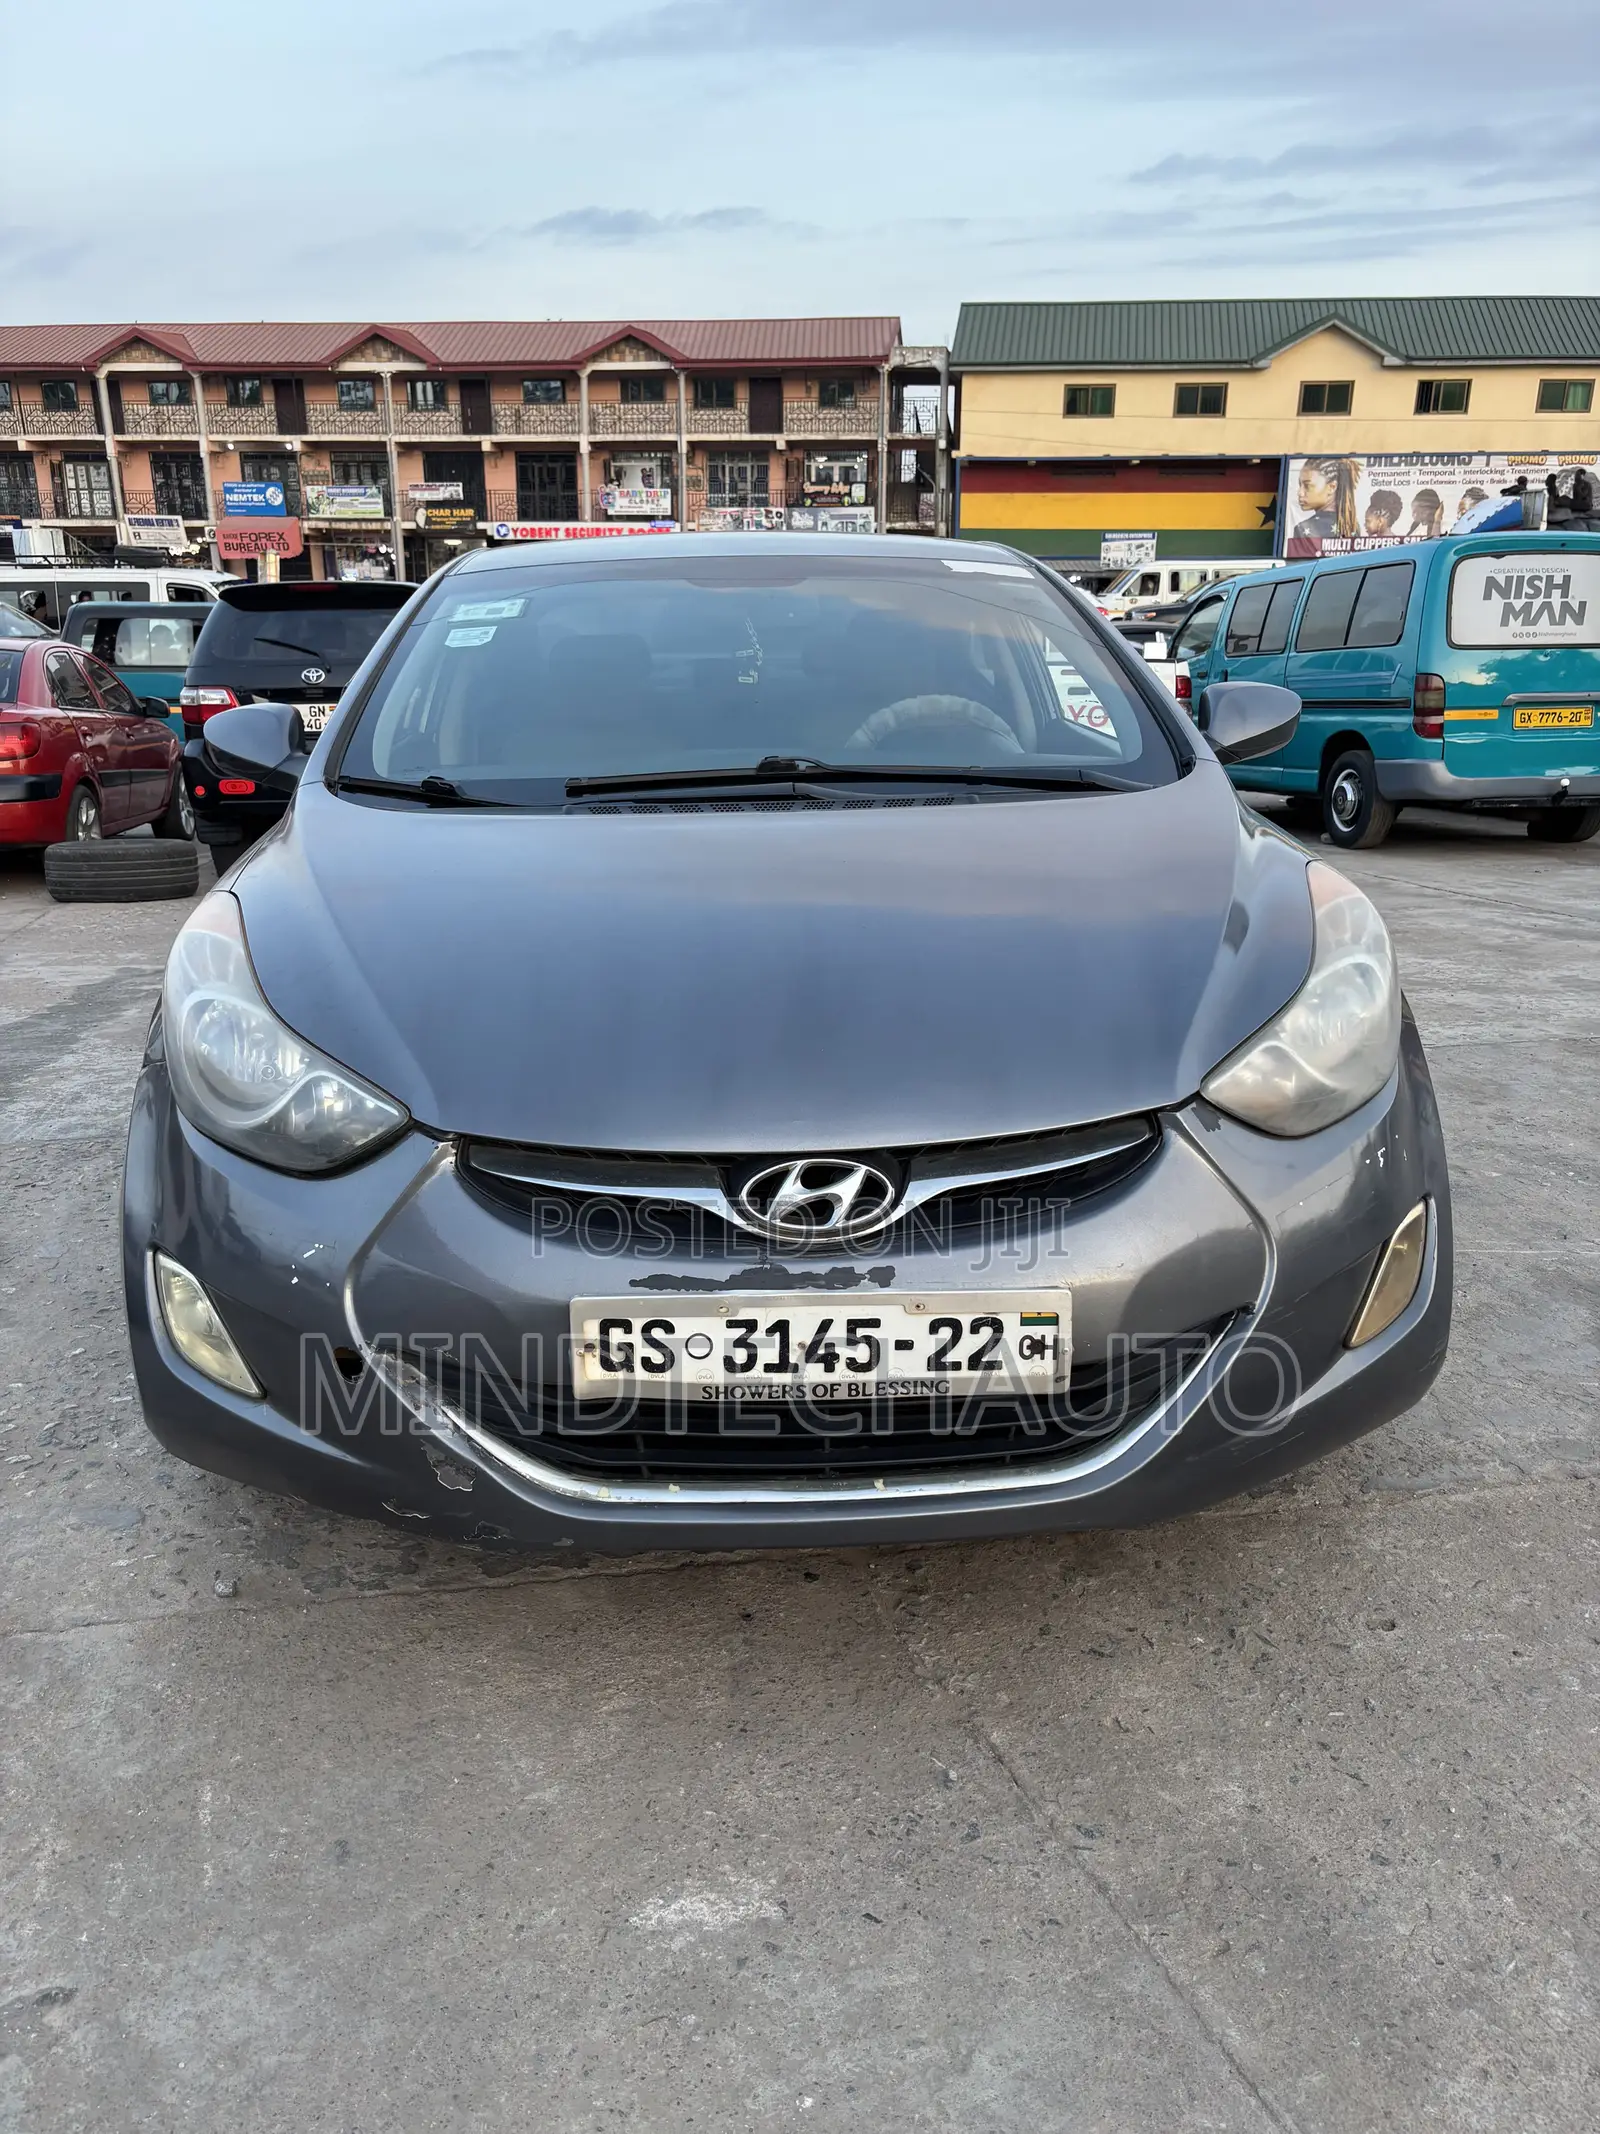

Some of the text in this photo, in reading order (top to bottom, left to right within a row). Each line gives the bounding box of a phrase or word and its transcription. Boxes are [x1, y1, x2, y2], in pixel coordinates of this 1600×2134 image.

[1507, 455, 1547, 466] PROMO
[1558, 455, 1597, 465] PROMO
[1368, 467, 1549, 478] Permanent Temporal Interlocking Treatment
[1371, 479, 1392, 487] Sister
[226, 494, 265, 502] NEMTEK
[619, 490, 669, 498] BABY DRIP
[427, 508, 474, 516] CHAR HAIR
[239, 532, 287, 542] FOREX
[511, 527, 560, 538] YOBENT
[564, 527, 624, 538] SECURITY
[224, 542, 290, 553] BUREAU LTD
[1322, 538, 1351, 551] MULTI
[1354, 537, 1401, 551] CLIPPERS
[1482, 575, 1572, 601] NISH
[1499, 601, 1588, 627] MAN
[309, 705, 326, 717] GN
[1519, 712, 1533, 724] GX
[600, 1318, 675, 1374] GS
[1018, 1334, 1058, 1361] GH
[701, 1379, 950, 1400] SHOWERS OF BLESSING
